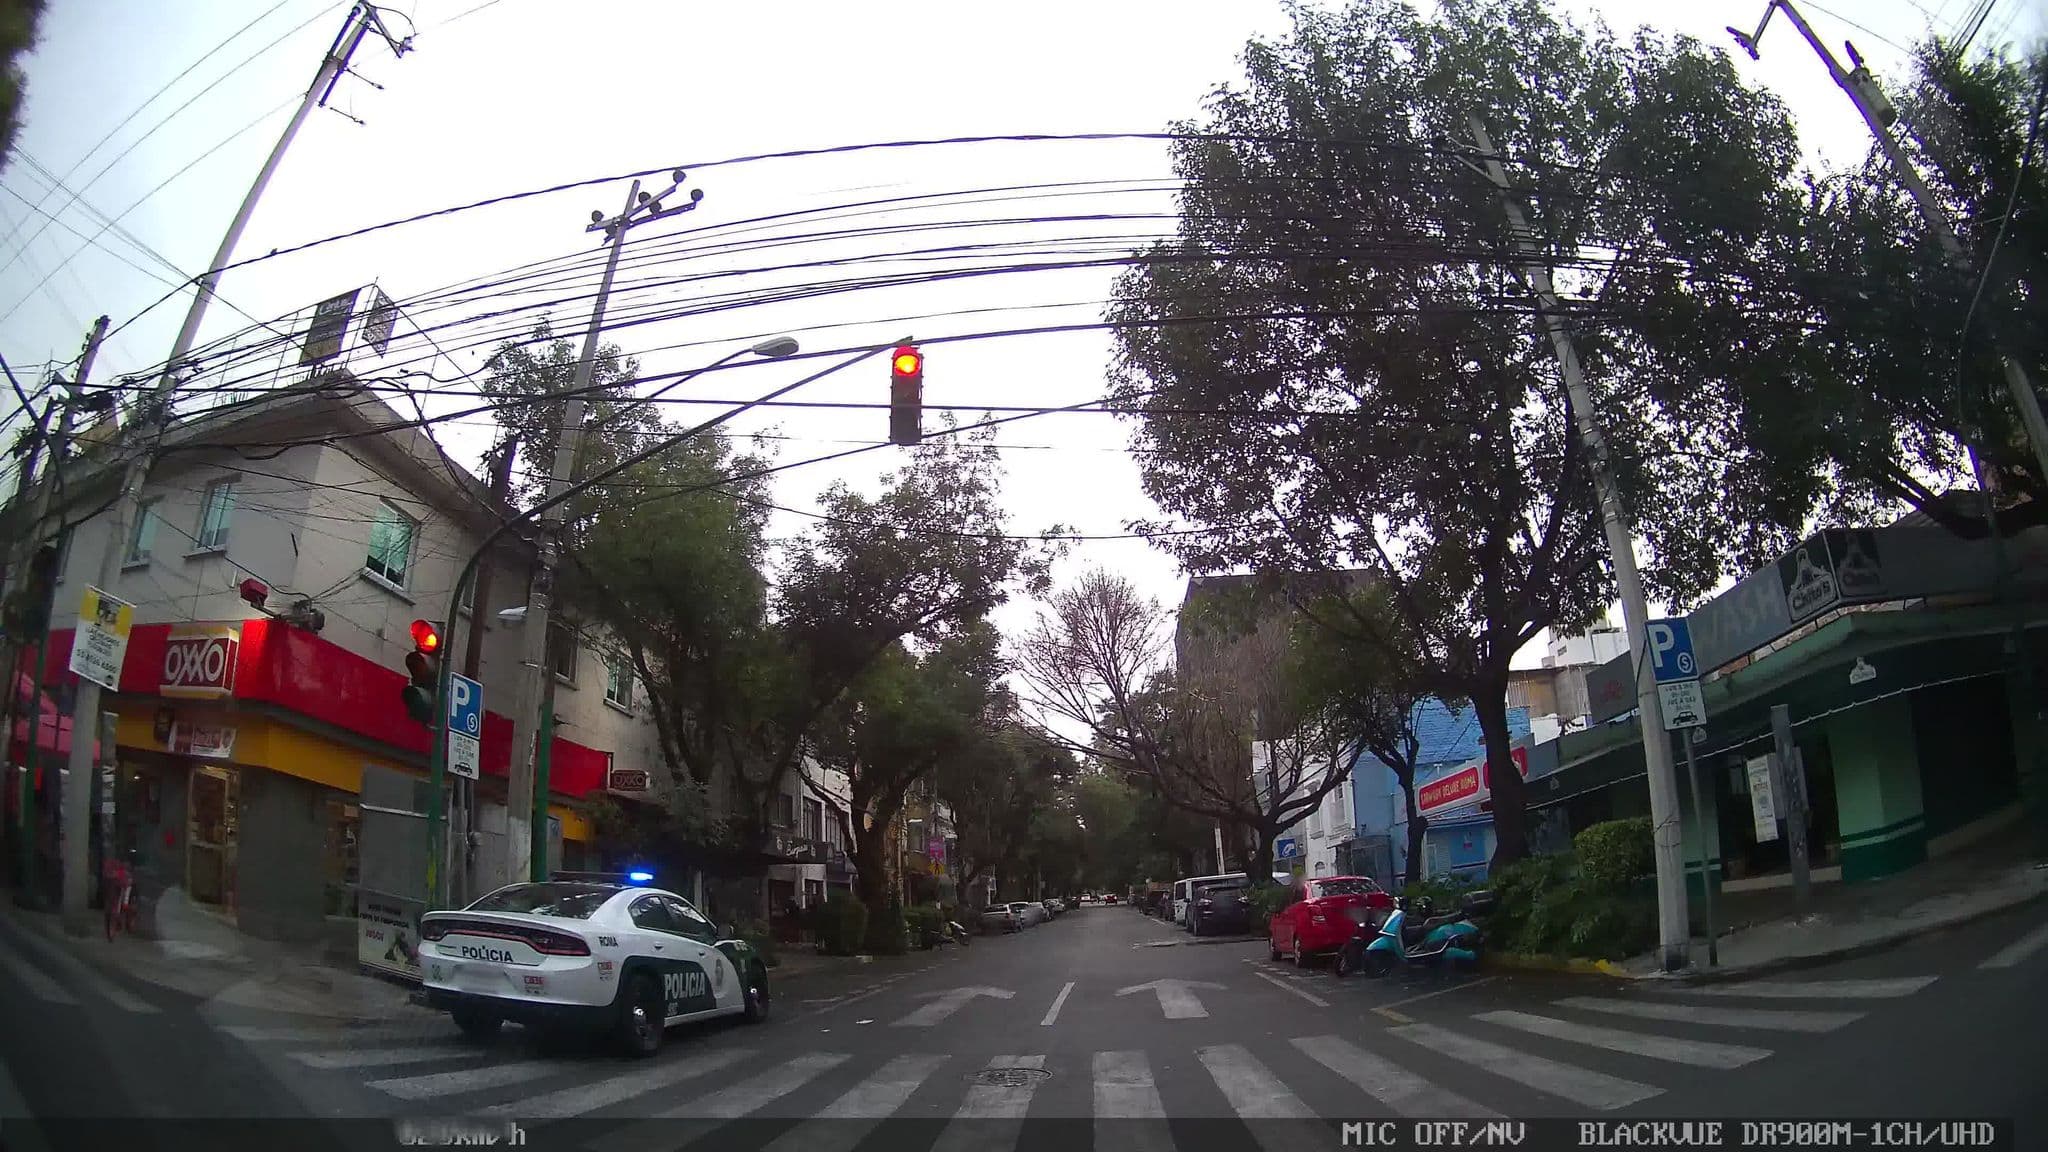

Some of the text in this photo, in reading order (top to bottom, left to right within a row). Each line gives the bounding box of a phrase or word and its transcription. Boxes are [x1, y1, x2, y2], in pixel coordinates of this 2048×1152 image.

[166, 637, 225, 685] OXXO
[1648, 624, 1674, 667] P
[451, 678, 470, 717] P
[613, 773, 645, 789] OXXO
[599, 936, 618, 947] ROMA
[664, 972, 706, 1001] POLICIA
